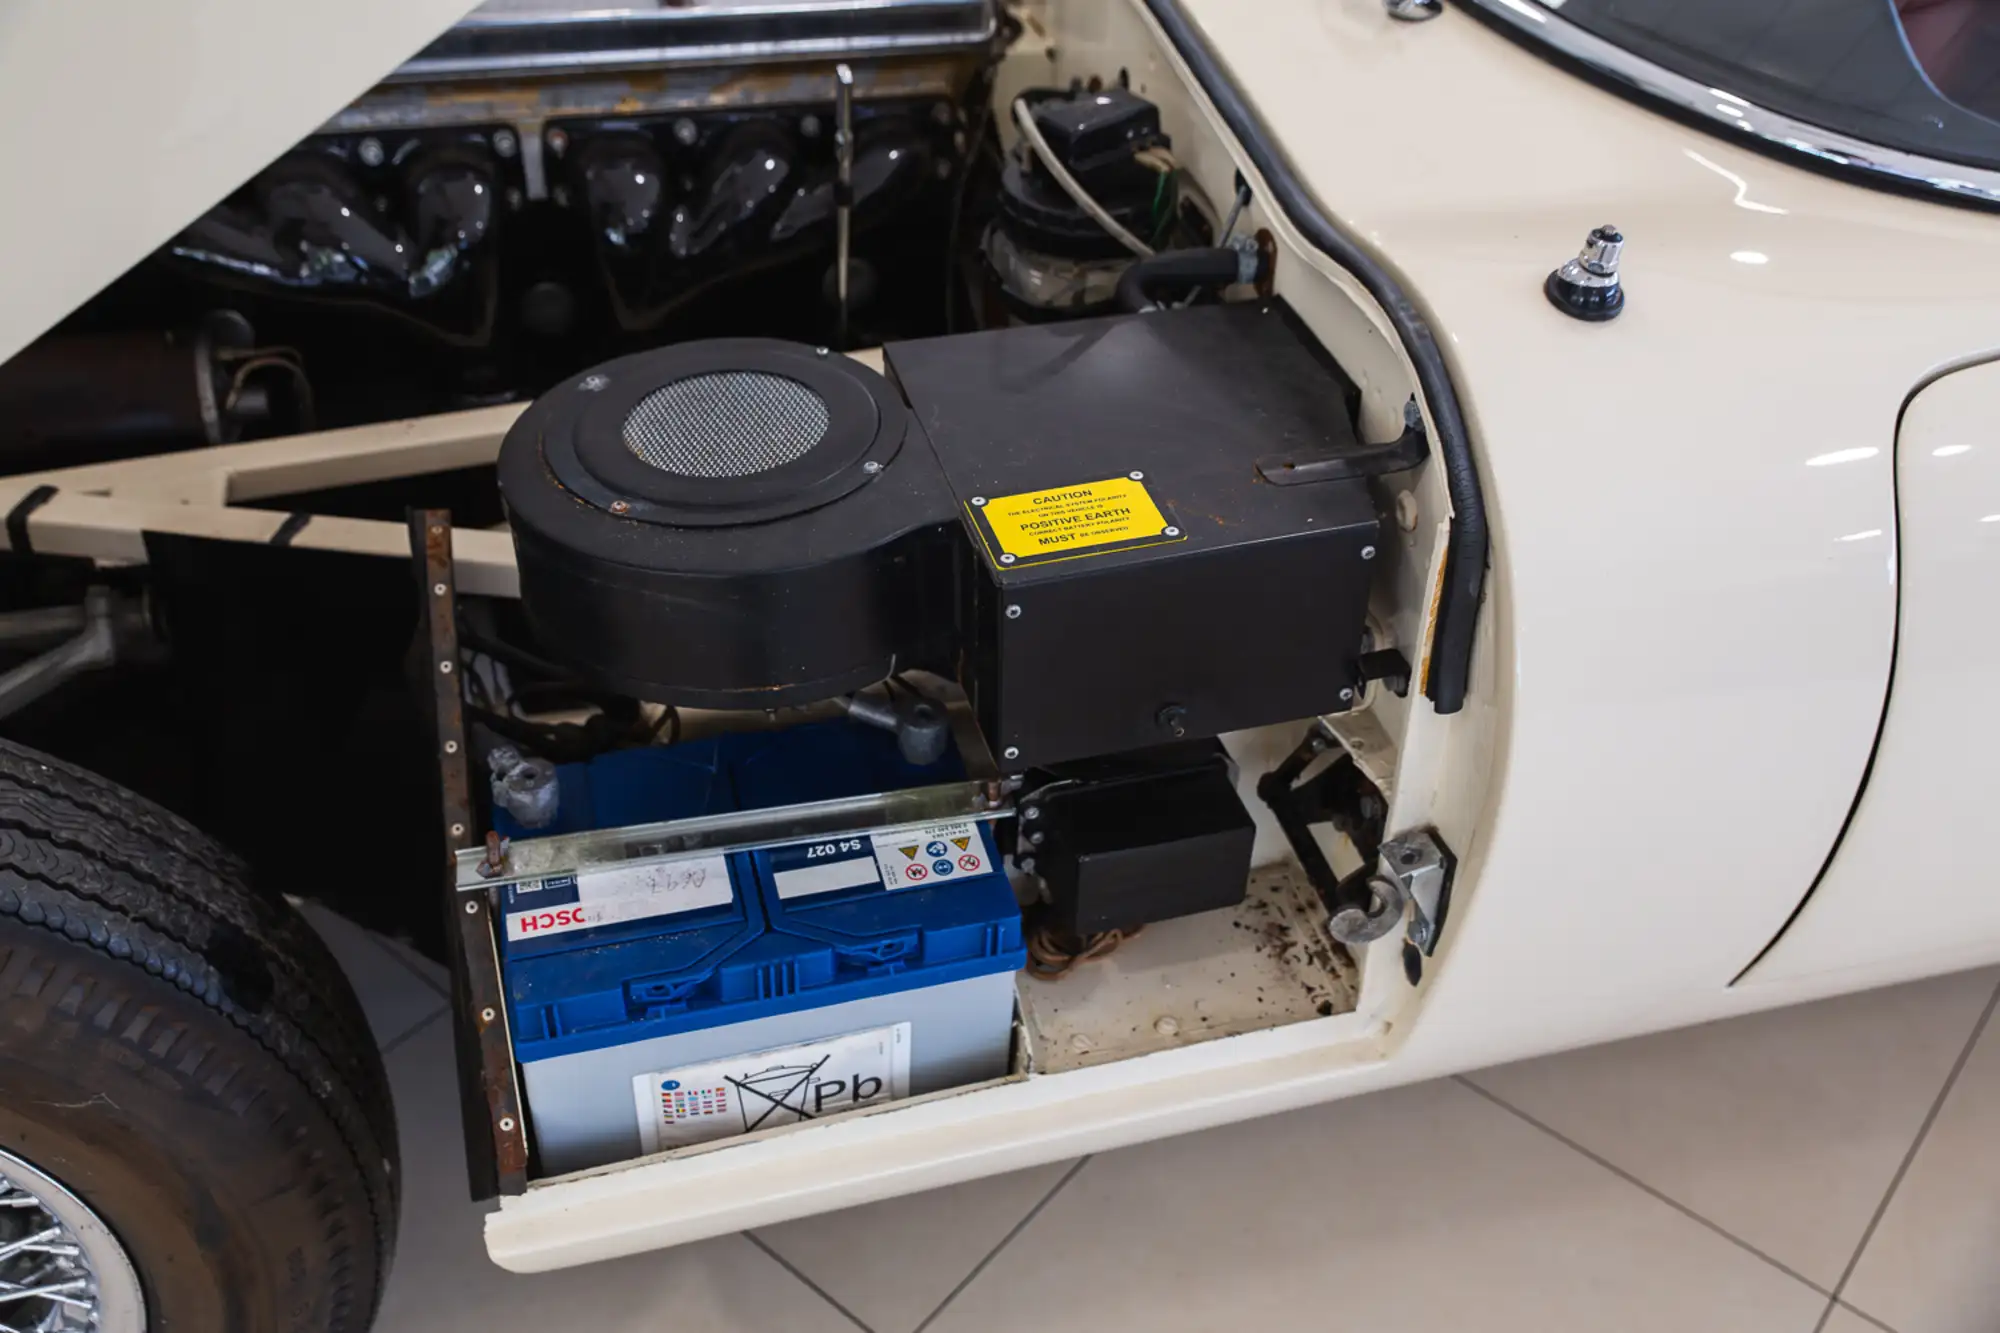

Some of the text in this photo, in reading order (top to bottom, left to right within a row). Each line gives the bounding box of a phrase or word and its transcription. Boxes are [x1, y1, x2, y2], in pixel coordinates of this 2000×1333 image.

[1033, 489, 1092, 505] CAUTION
[1065, 498, 1093, 508] SYSTEM
[1066, 505, 1095, 513] VEHICLE
[1020, 507, 1131, 531] POSITIVE EARTH
[1028, 527, 1062, 537] CORRECT
[1063, 522, 1095, 531] BATTERY
[1038, 532, 1076, 546] MUST
[1091, 525, 1129, 536] OBSERVED
[806, 844, 837, 859] 027
[840, 838, 862, 853] S4
[520, 907, 587, 933] OSCH
[814, 1072, 883, 1113] Pb
